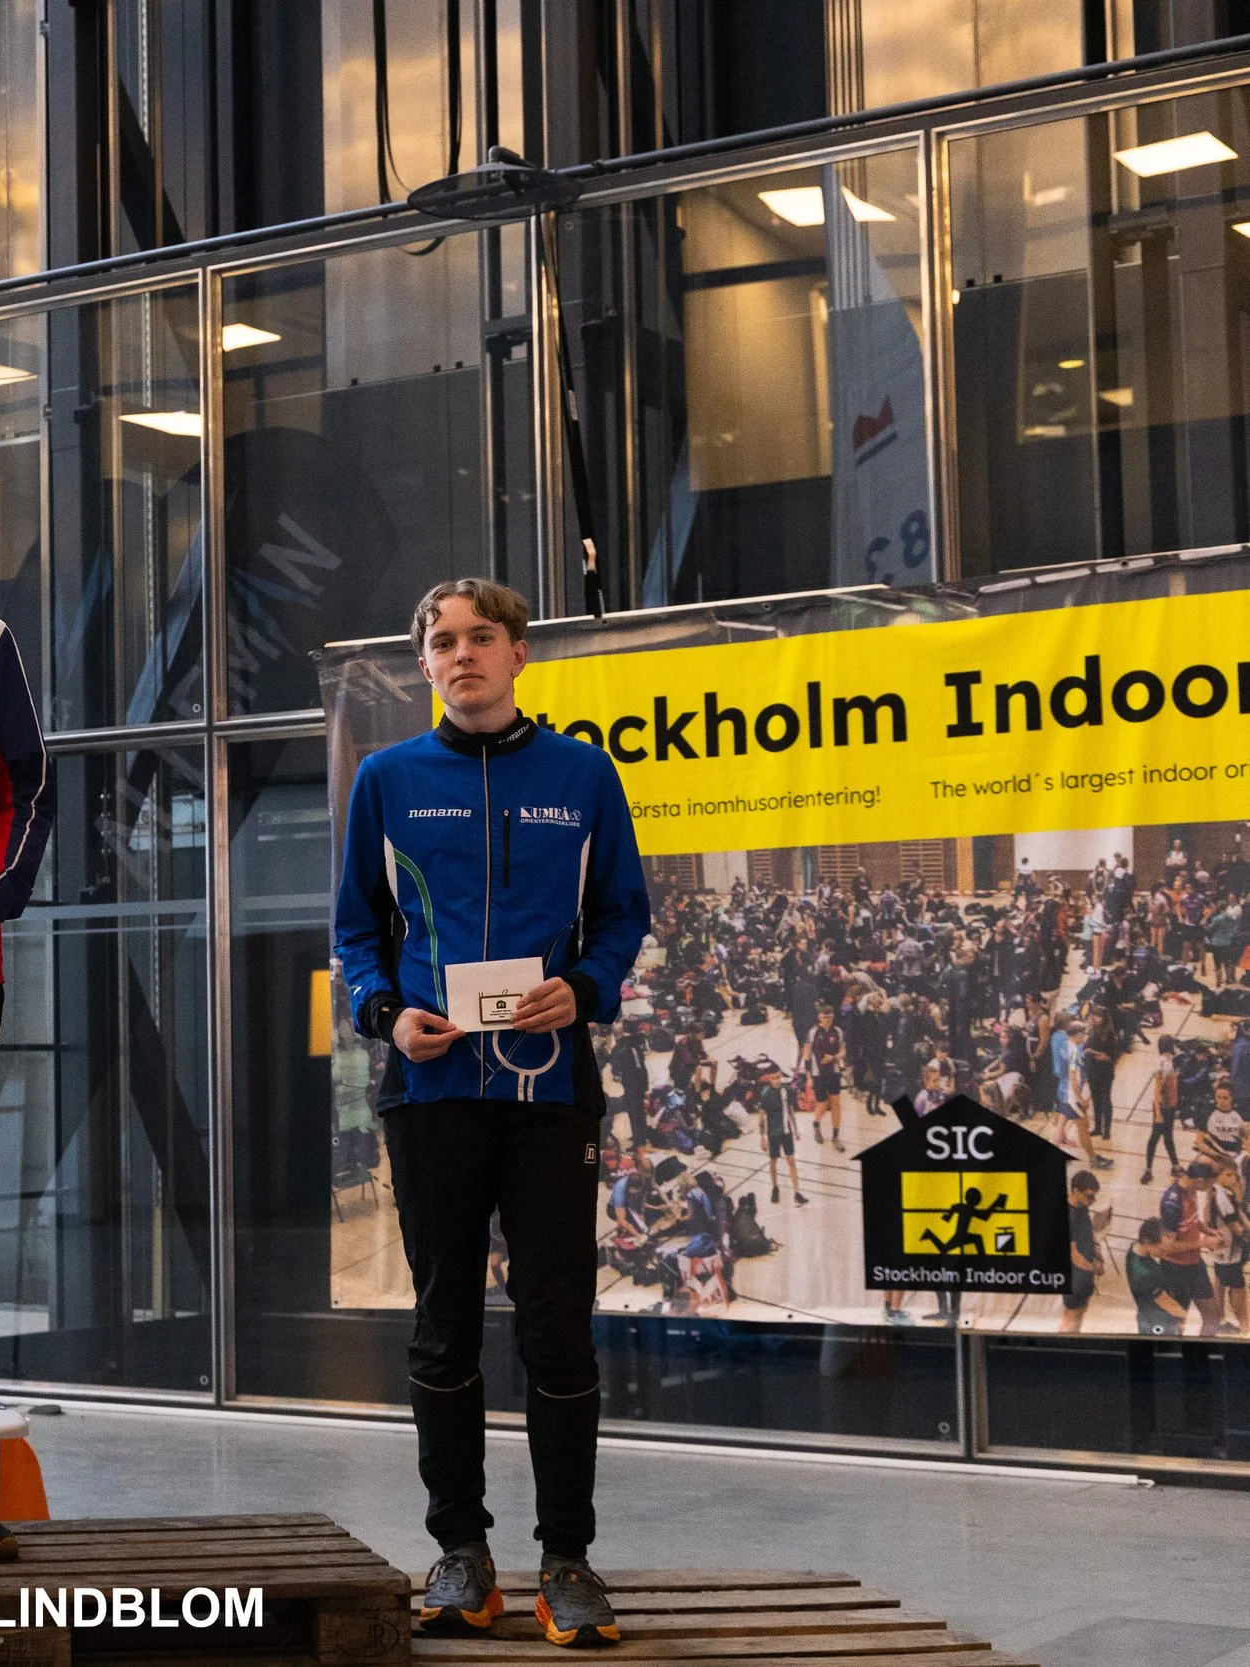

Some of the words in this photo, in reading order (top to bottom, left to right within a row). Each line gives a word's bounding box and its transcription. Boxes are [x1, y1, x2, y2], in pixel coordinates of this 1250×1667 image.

[537, 681, 908, 764] ockholm
[930, 780, 967, 799] The
[1060, 768, 1135, 793] largest
[1142, 763, 1217, 784] indoor
[1224, 761, 1250, 780] or
[408, 808, 472, 819] noname
[631, 801, 681, 819] örsta
[687, 786, 881, 816] inomhusorientering!
[926, 1125, 995, 1160] SIC
[873, 1265, 960, 1284] Stockholm
[965, 1266, 1025, 1285] Indoor
[1029, 1269, 1066, 1289] Cup
